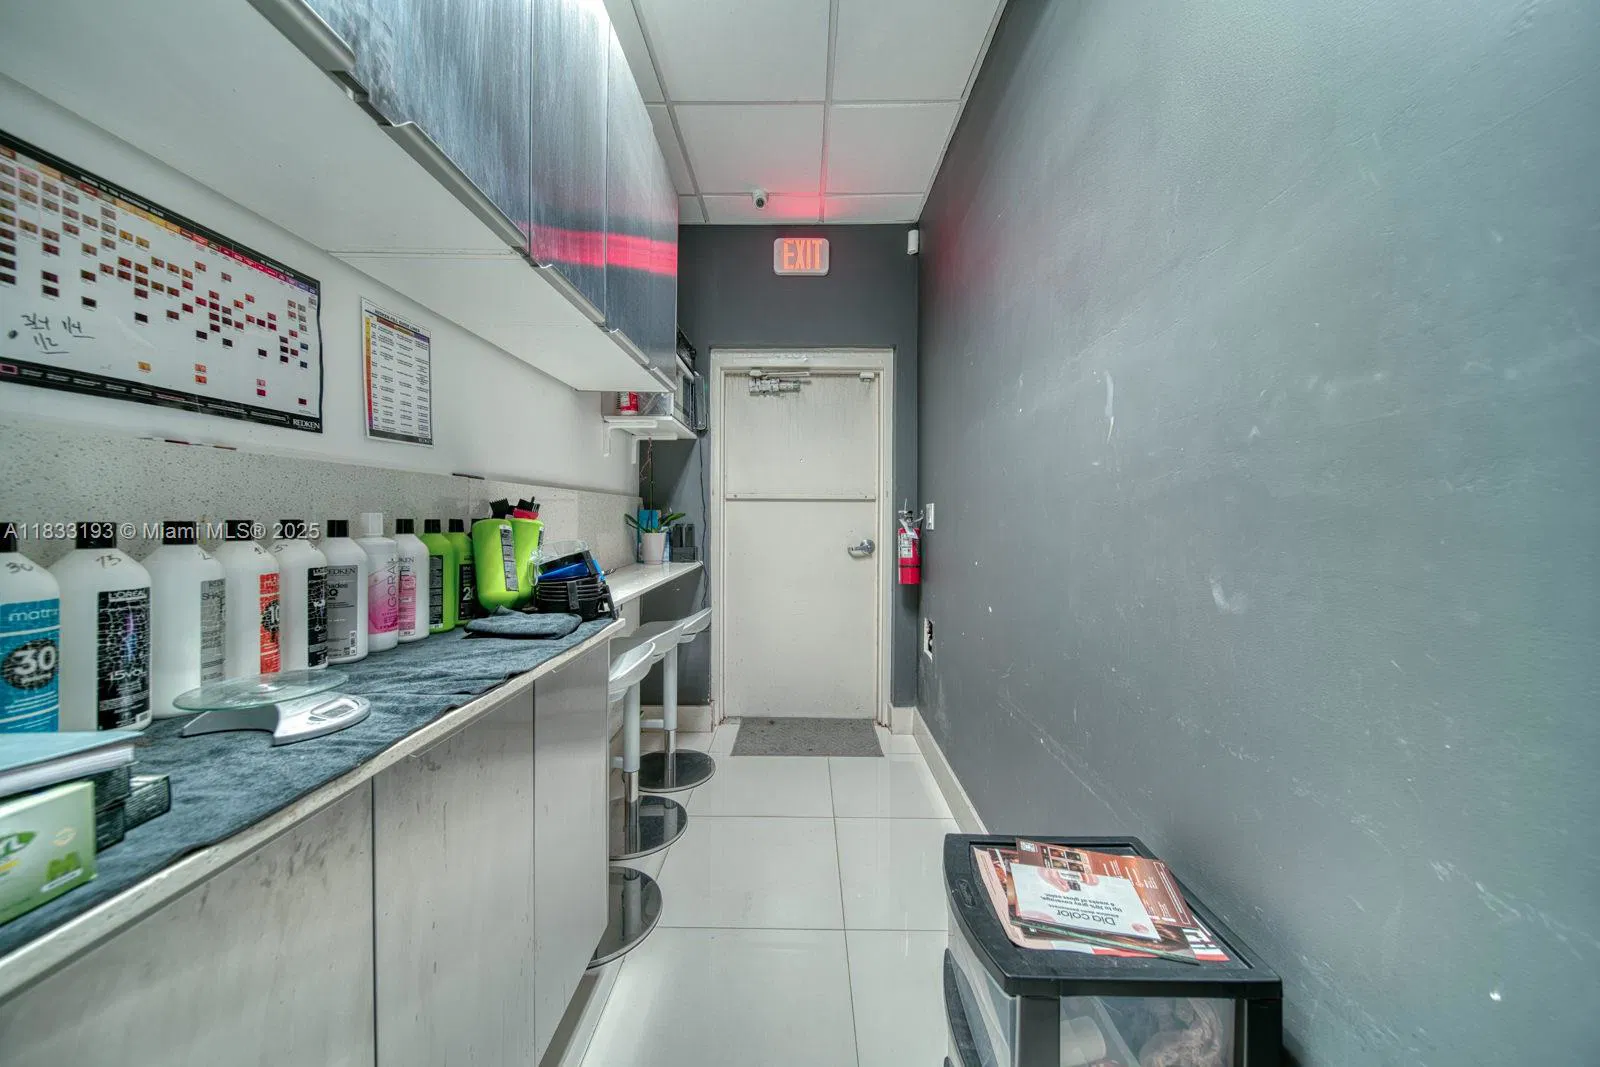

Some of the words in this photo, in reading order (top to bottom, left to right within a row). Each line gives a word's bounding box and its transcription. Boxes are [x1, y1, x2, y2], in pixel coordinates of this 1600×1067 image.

[783, 239, 823, 270] EXIT
[292, 418, 320, 429] REDKEN
[13, 645, 56, 676] 30
[1057, 909, 1090, 920] color
